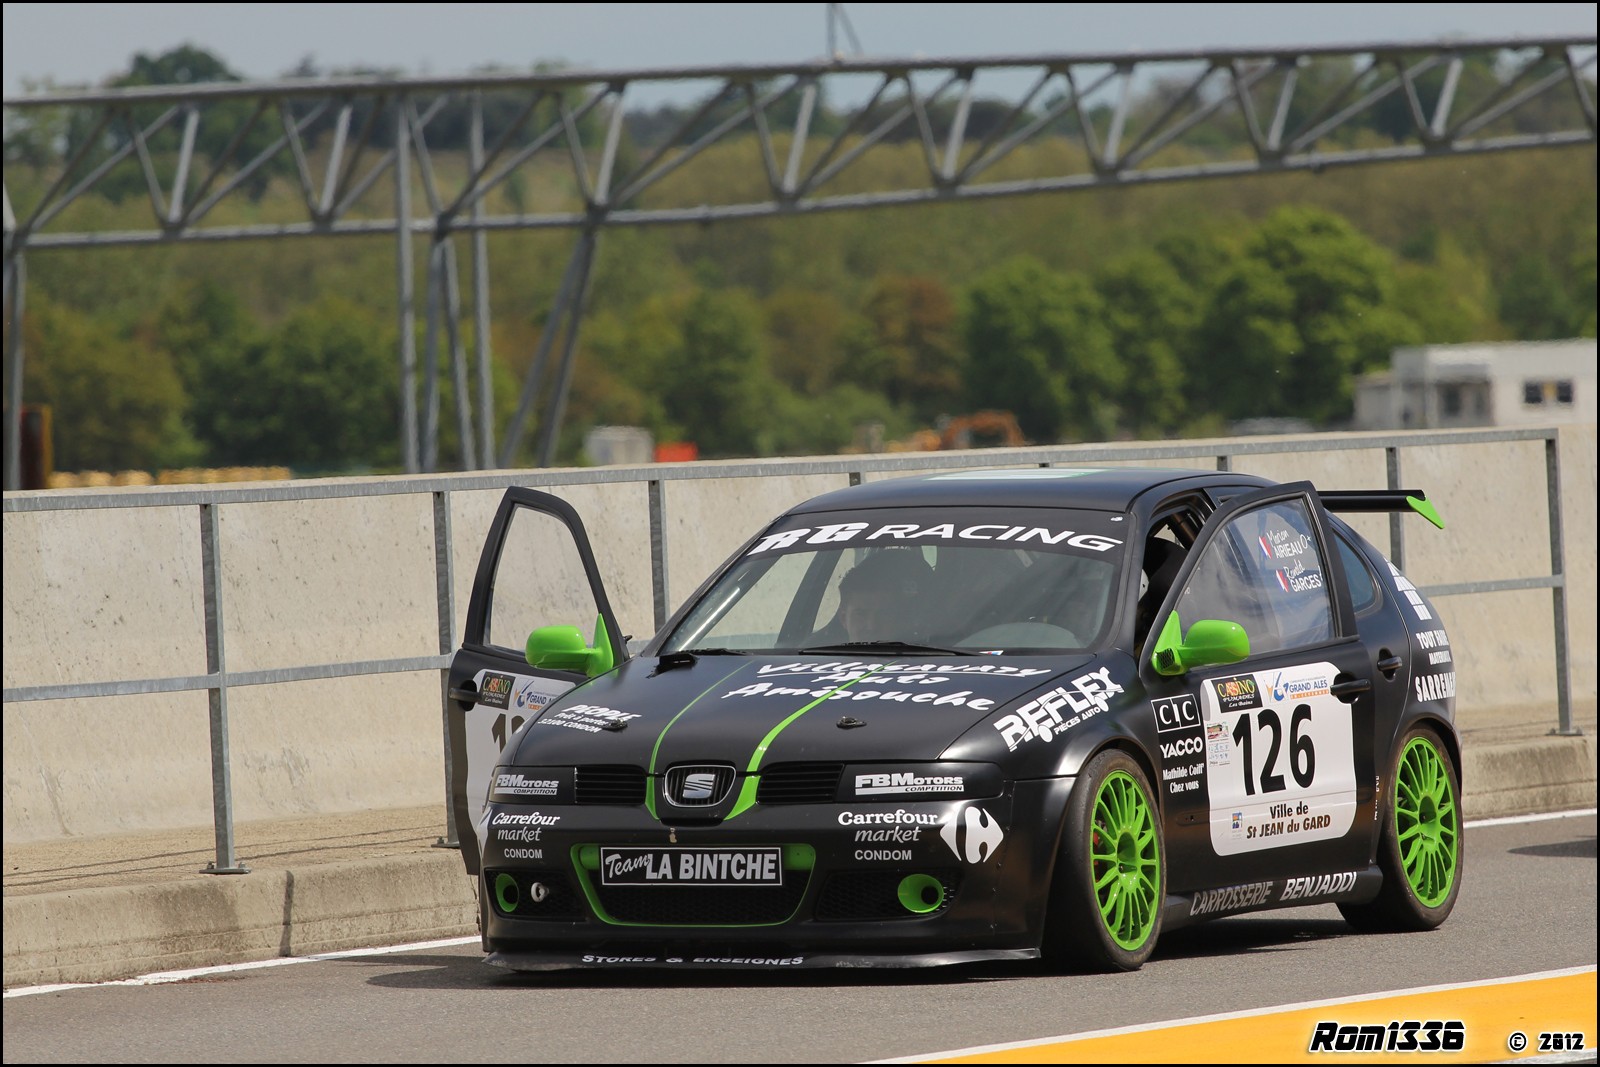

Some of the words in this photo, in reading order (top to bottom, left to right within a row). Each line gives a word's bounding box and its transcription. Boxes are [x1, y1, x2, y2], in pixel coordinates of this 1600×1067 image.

[746, 522, 869, 556] RG
[866, 524, 1124, 551] RACING
[1290, 574, 1321, 592] GARCES
[1415, 631, 1437, 649] TOUT
[1289, 682, 1311, 693] GRAND
[993, 666, 1125, 752] REFLEX
[1081, 706, 1101, 721] AUTO
[1158, 699, 1195, 725] CIC
[1160, 737, 1203, 759] YACCO
[1232, 703, 1316, 796] 126
[1162, 766, 1188, 780] Mathilde
[904, 785, 963, 793] COMPETITION
[1169, 782, 1184, 793] Chez
[1185, 780, 1199, 790] vous
[838, 809, 938, 826] Carrefour
[1270, 804, 1293, 819] Ville
[1296, 801, 1309, 815] de
[492, 812, 560, 826] Carrefour
[1246, 825, 1257, 839] St
[1259, 821, 1285, 837] JEAN
[1286, 818, 1300, 832] du
[1303, 814, 1331, 830] GARD
[497, 826, 542, 843] market
[854, 826, 922, 843] market
[504, 848, 543, 859] CONDOM
[854, 849, 912, 861] CONDOM
[605, 853, 650, 878] Team
[646, 853, 673, 880] LA
[679, 853, 777, 880] BINTCHE
[1189, 881, 1274, 917] CARROSSERIE
[1279, 871, 1358, 901] BENJADDI
[582, 955, 656, 963] STORES
[693, 956, 804, 966] ENSEIGNES
